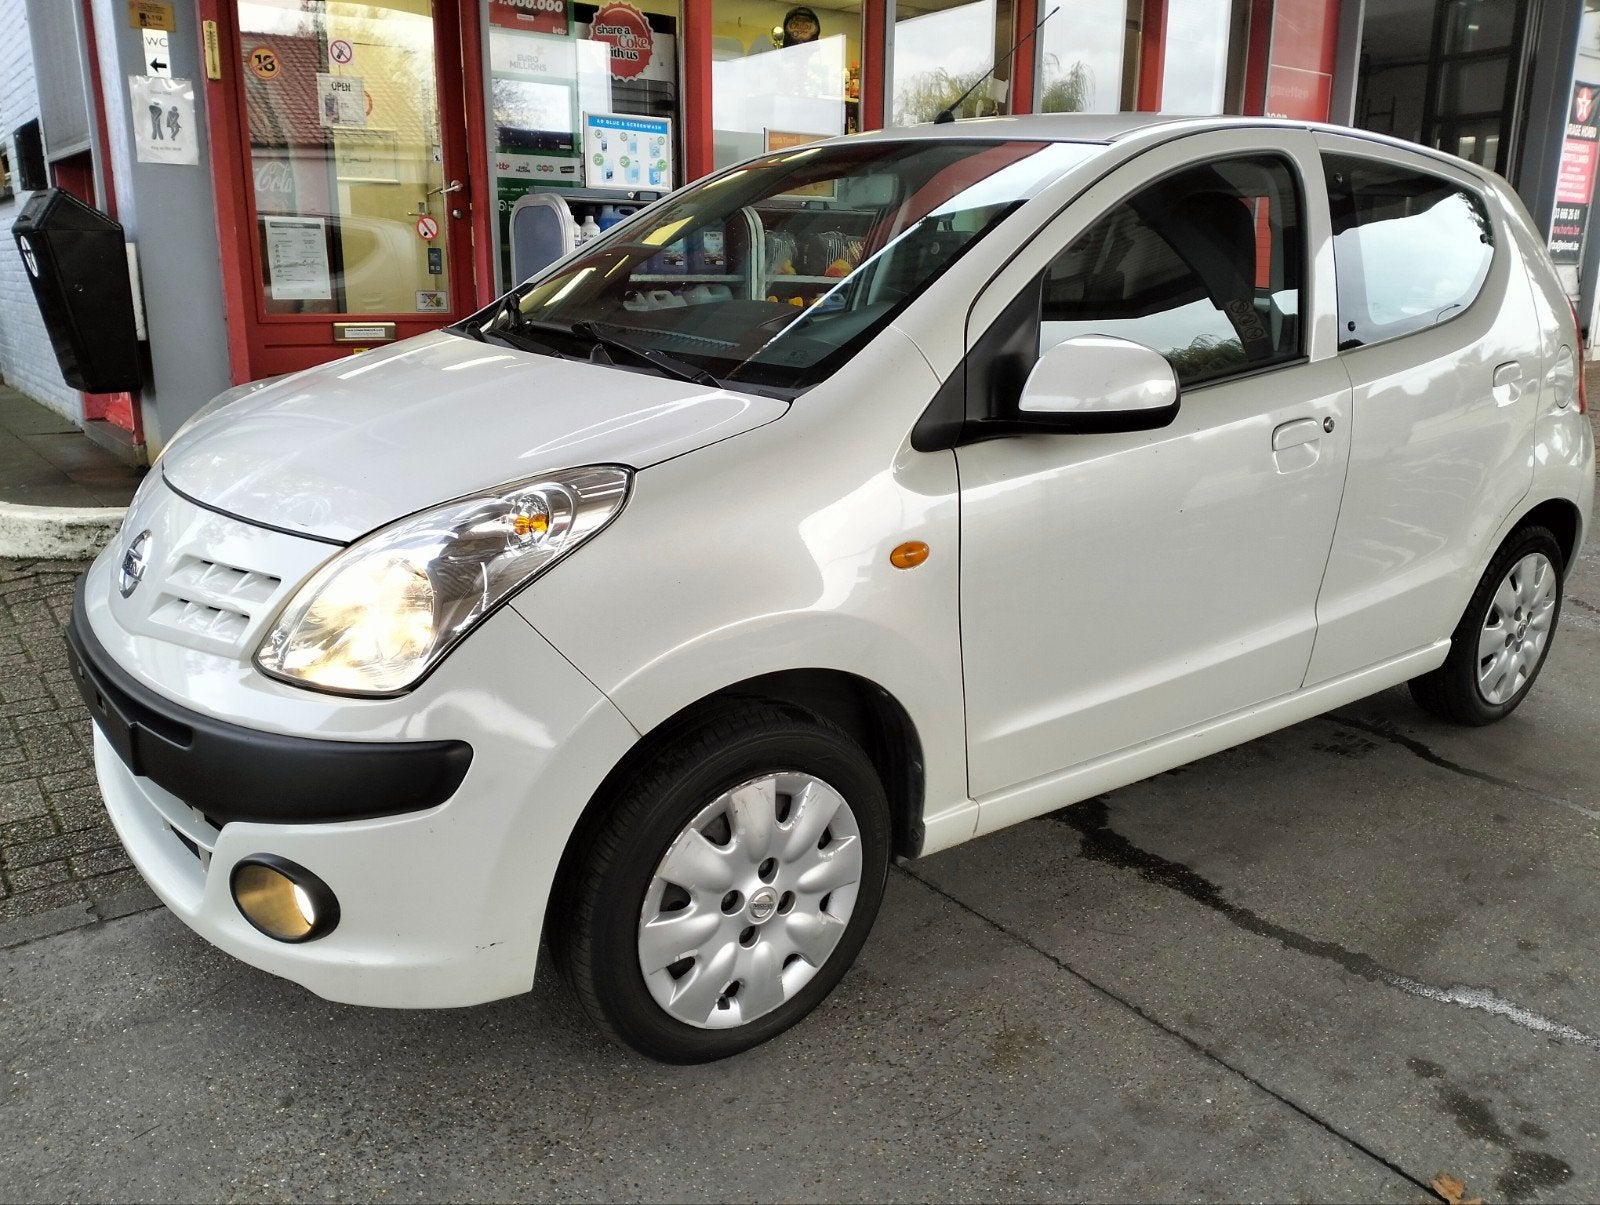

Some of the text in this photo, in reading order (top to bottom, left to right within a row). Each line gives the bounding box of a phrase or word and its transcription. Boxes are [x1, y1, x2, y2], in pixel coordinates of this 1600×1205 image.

[596, 24, 631, 35] share a
[145, 36, 169, 48] WC
[617, 34, 650, 49] Coke
[517, 54, 539, 63] EURO
[610, 47, 638, 60] ith us
[254, 54, 276, 72] 18
[509, 61, 547, 72] MILLIONS
[331, 81, 351, 92] OPEN
[254, 161, 293, 193] Cola
